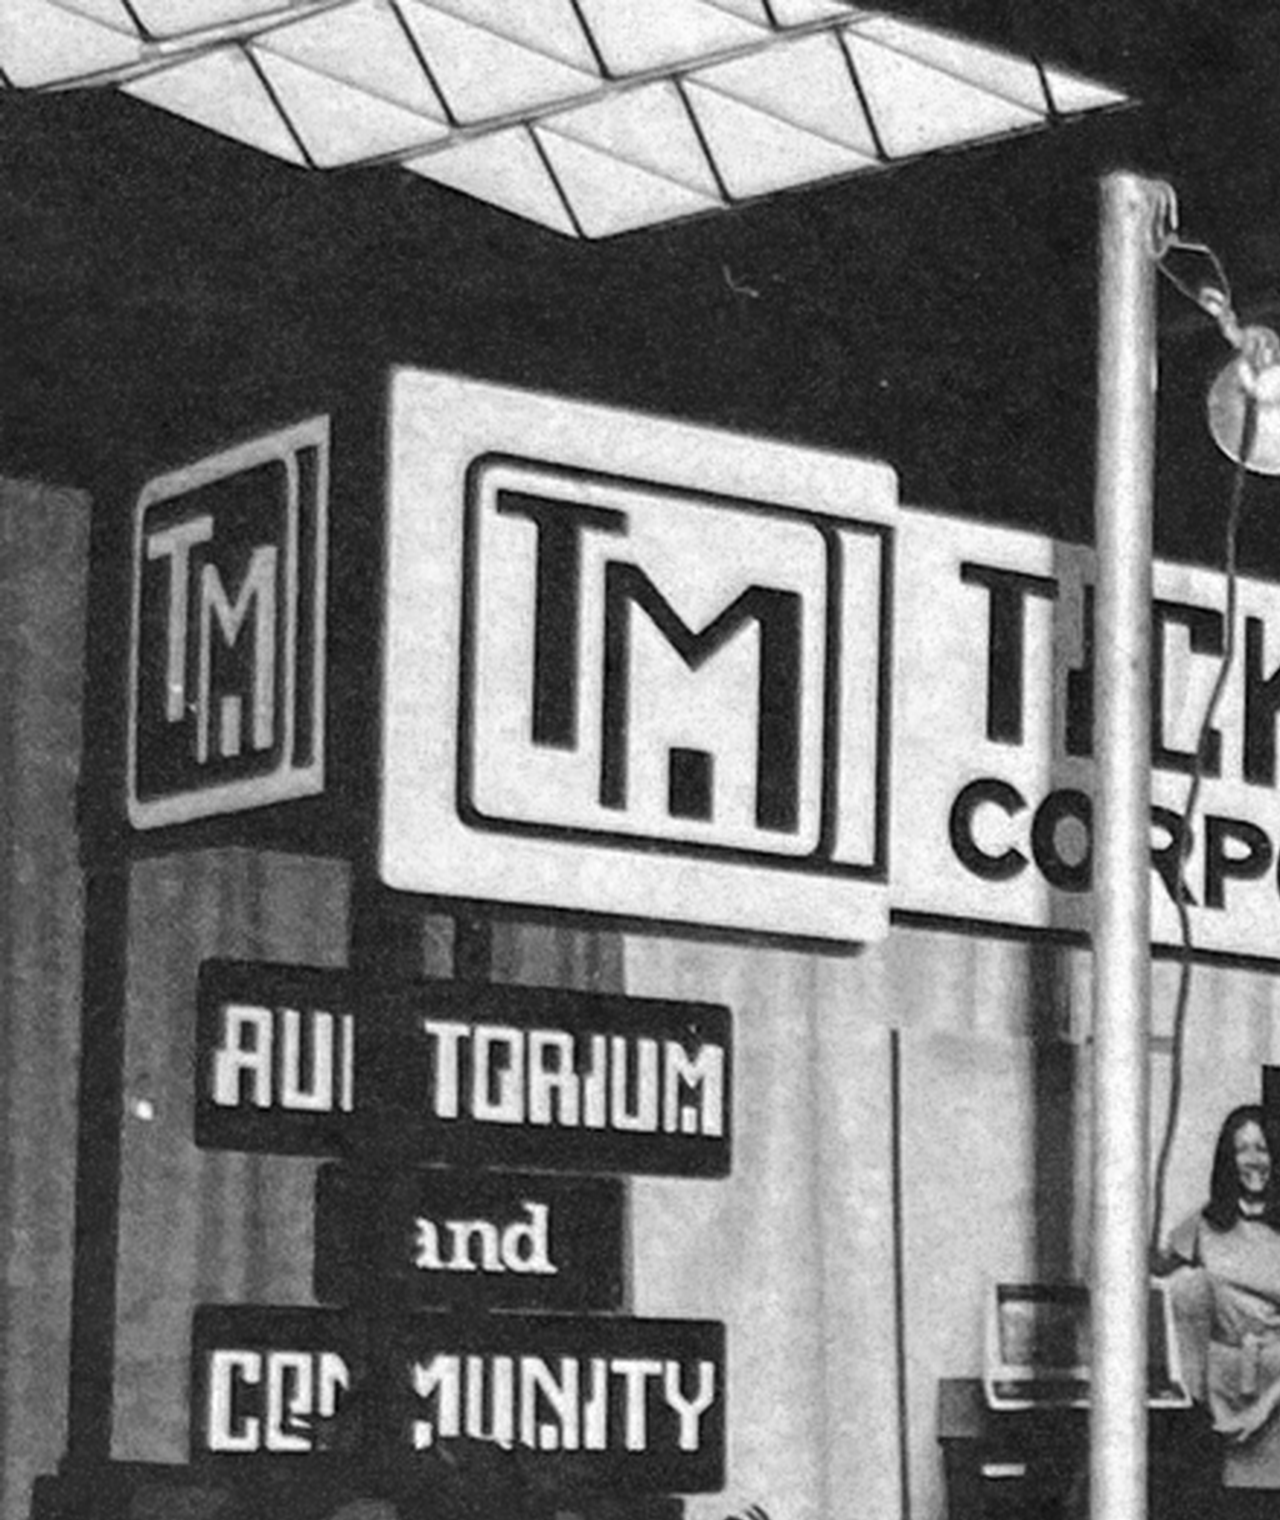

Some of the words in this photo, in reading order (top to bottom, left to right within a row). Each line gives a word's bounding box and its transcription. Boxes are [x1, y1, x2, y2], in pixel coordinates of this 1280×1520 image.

[496, 488, 802, 835] TM
[211, 1004, 725, 1137] AUTORIUM
[414, 1201, 558, 1275] and
